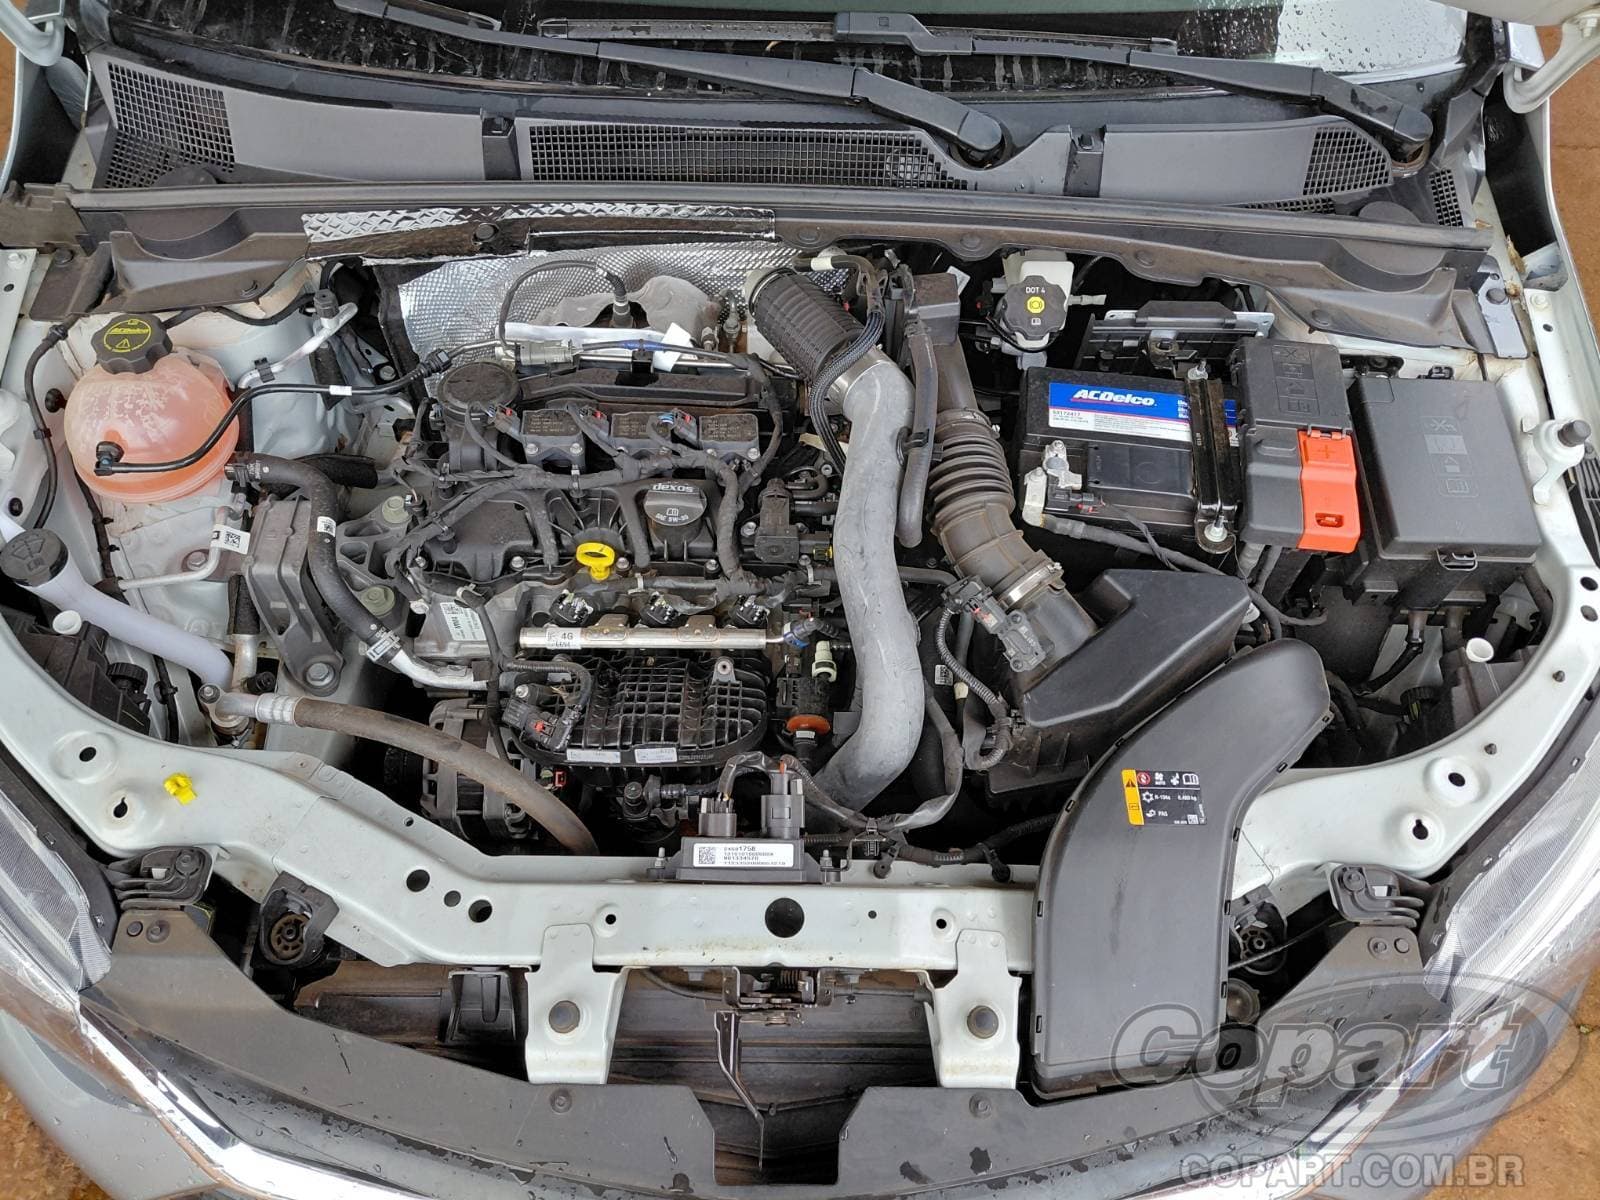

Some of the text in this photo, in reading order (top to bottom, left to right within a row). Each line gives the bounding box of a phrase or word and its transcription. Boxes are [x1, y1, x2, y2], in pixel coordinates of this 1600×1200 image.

[1025, 286, 1046, 294] DOT 4
[1072, 388, 1156, 407] ACDelco
[652, 482, 694, 493] dexos
